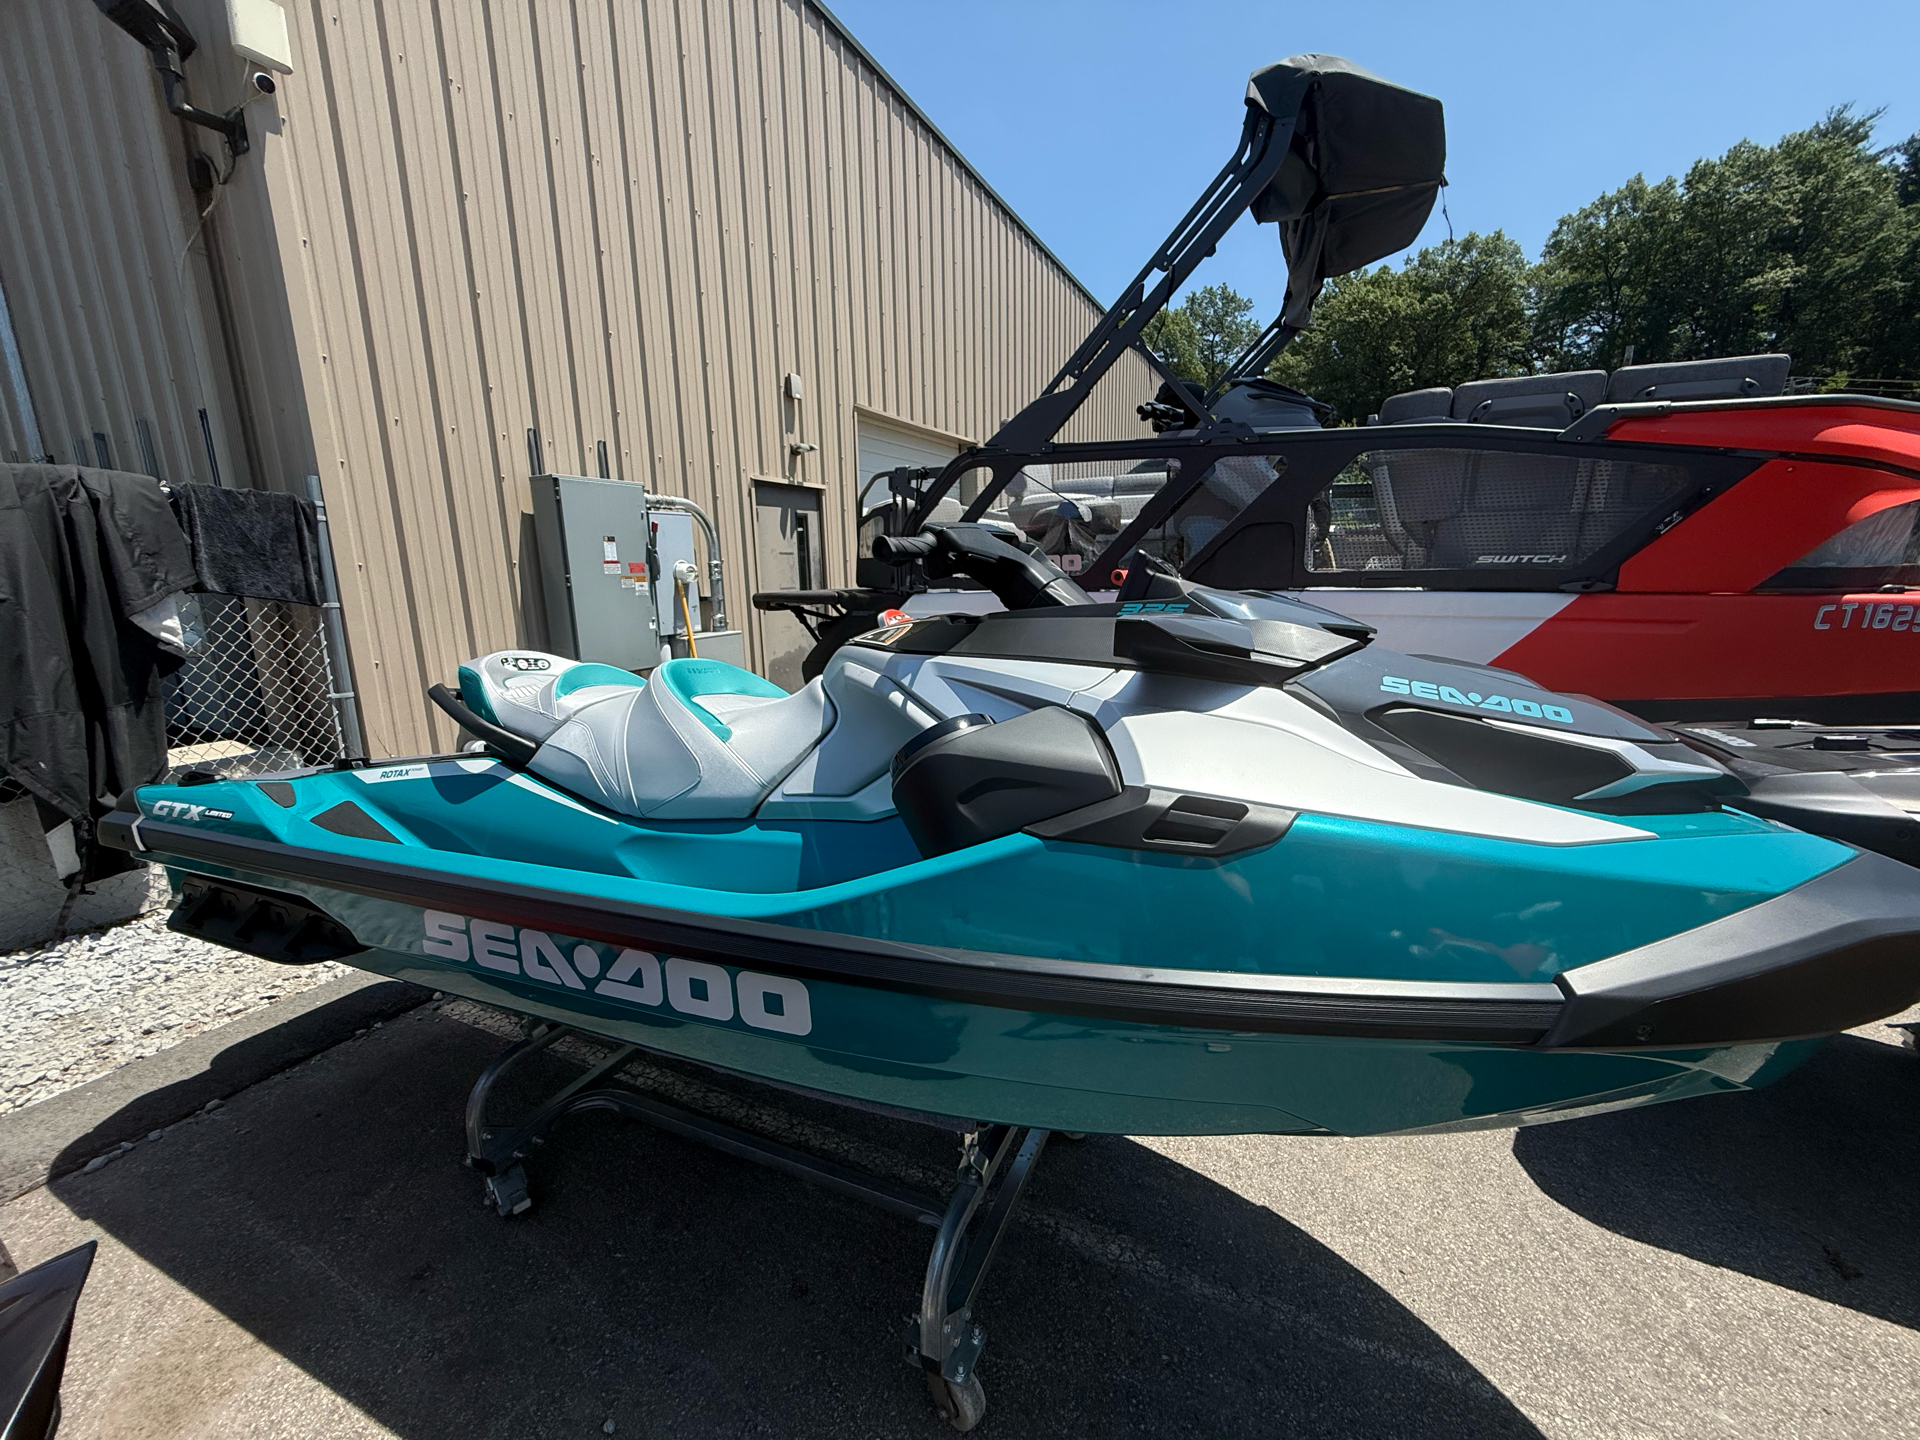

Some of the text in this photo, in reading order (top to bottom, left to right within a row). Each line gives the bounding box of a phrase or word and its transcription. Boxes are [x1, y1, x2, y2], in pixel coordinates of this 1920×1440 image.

[1476, 554, 1567, 564] SWITCH
[380, 769, 411, 780] ROTAX
[152, 800, 207, 821] GTX
